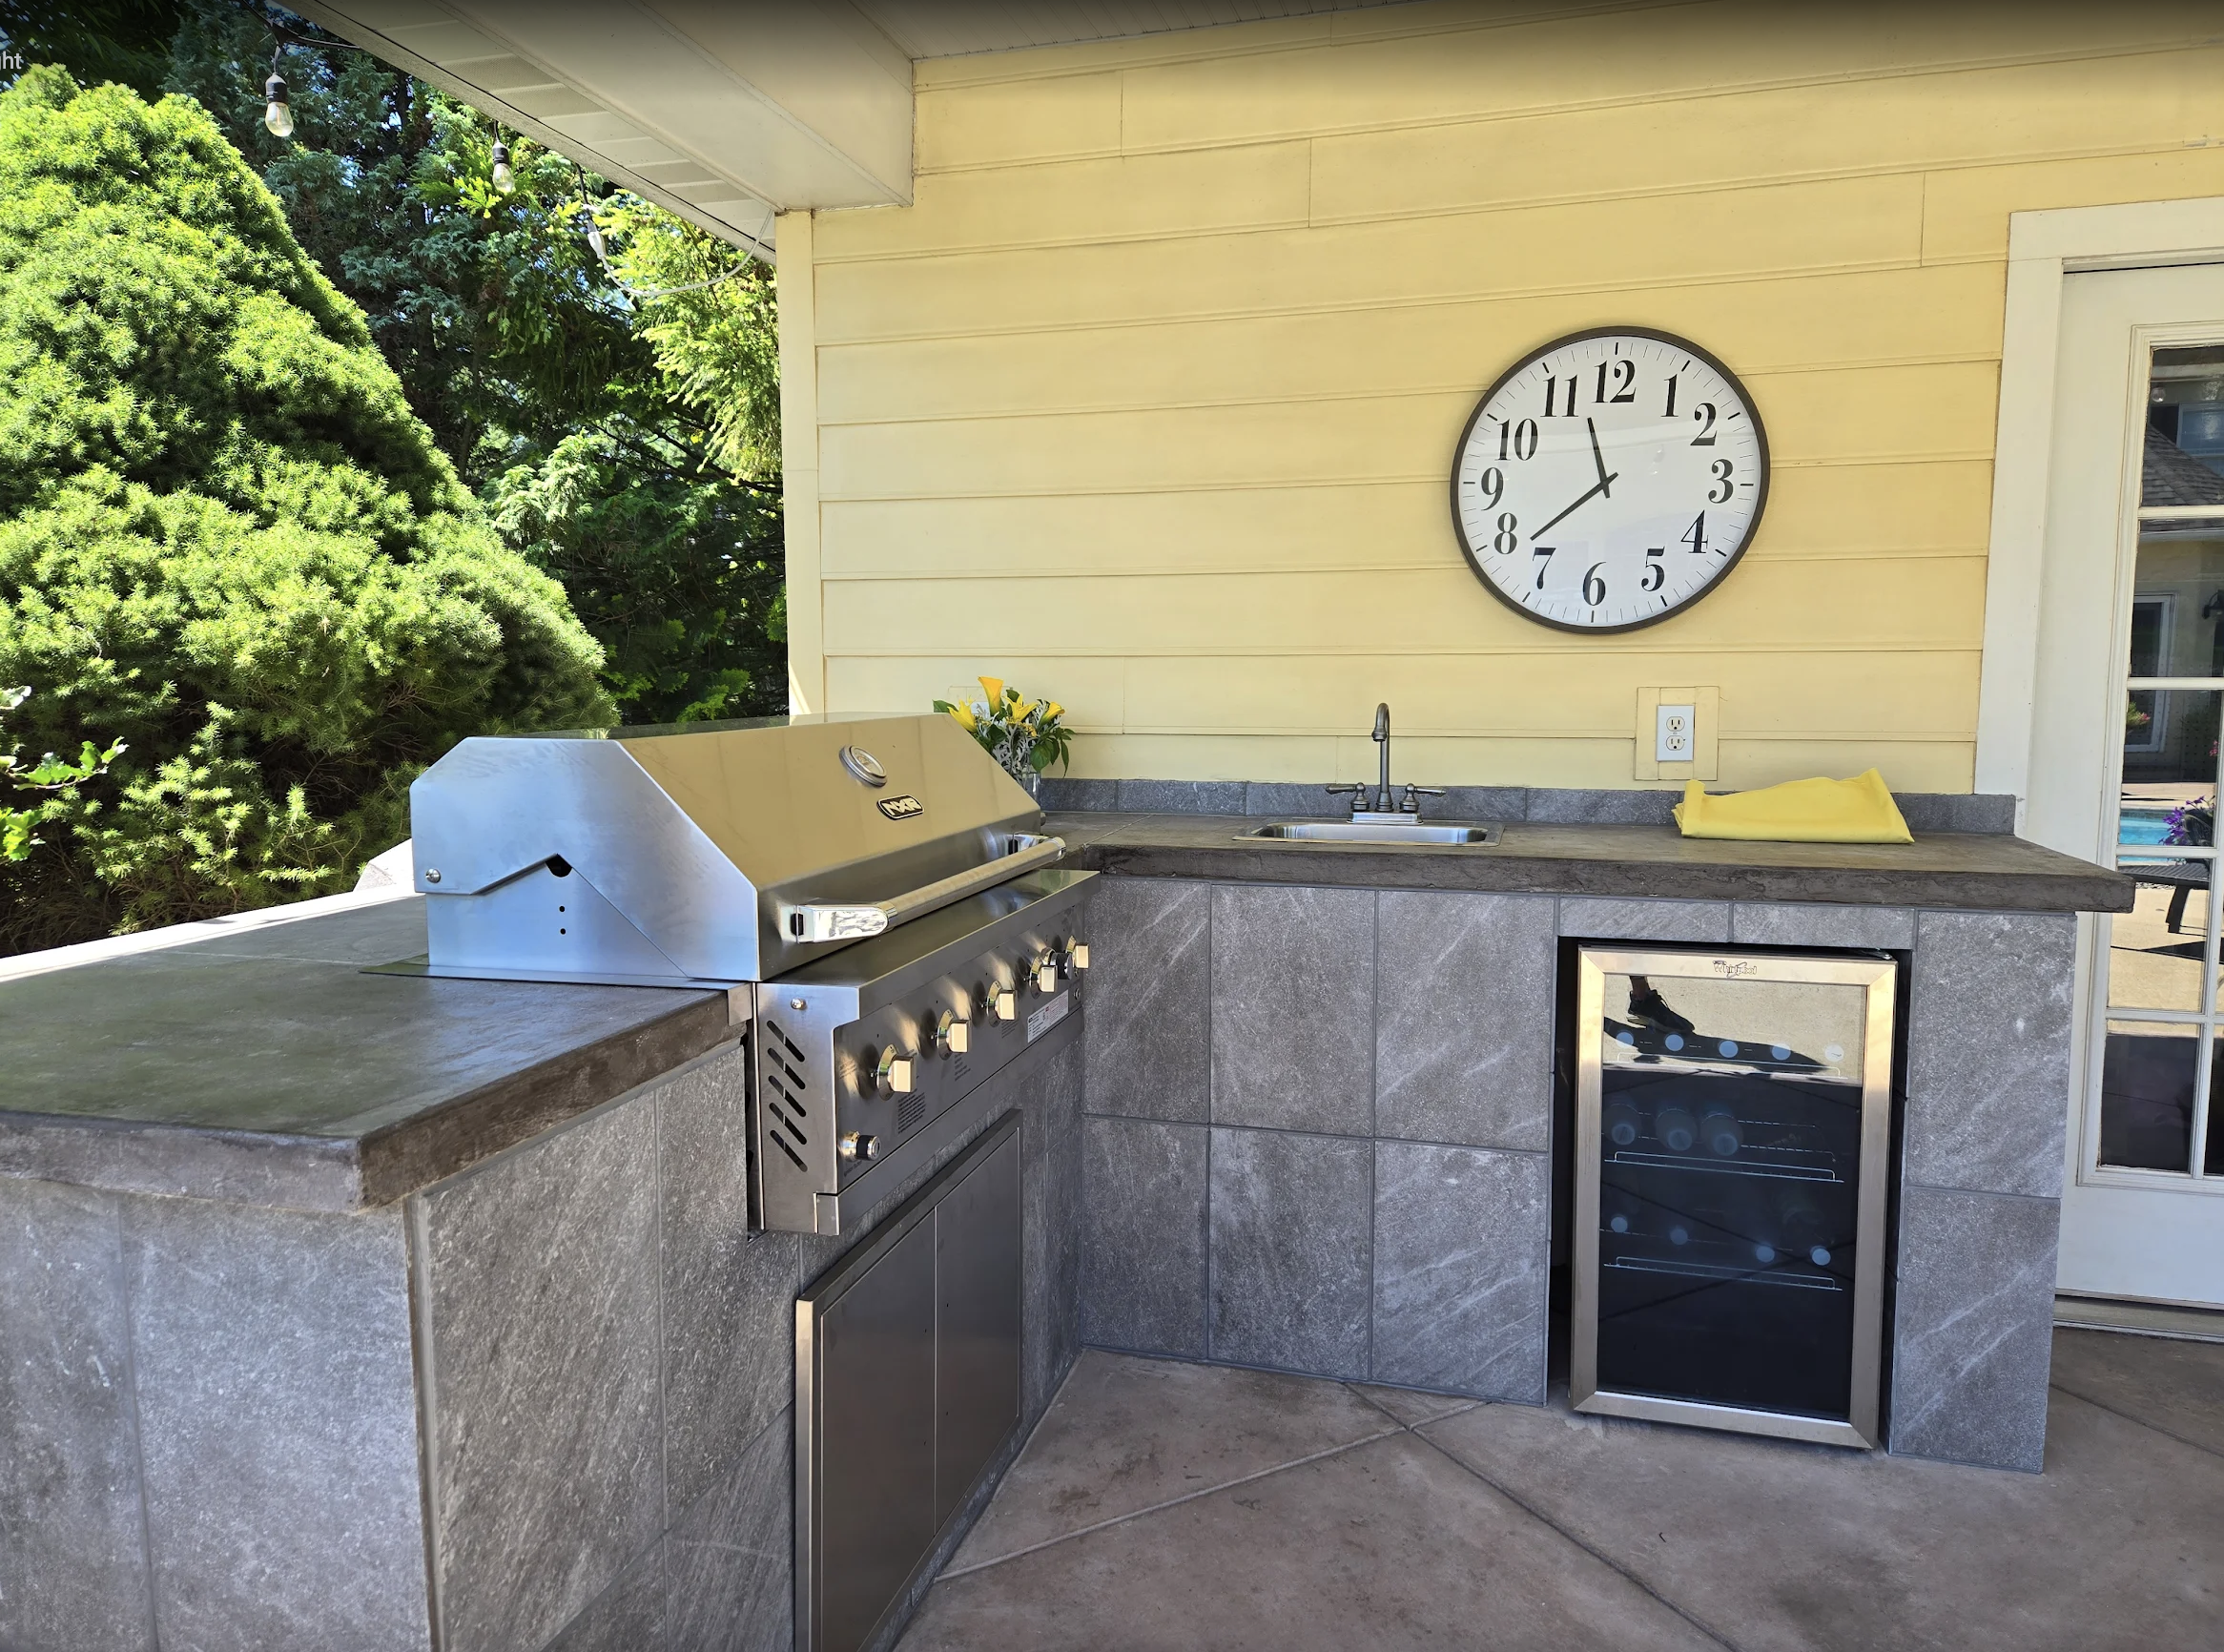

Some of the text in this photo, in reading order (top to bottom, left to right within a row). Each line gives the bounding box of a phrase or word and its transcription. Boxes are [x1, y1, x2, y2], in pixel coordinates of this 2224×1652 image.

[1539, 374, 1579, 418] 11
[1591, 360, 1637, 403] 12
[1660, 373, 1678, 418] 1
[1494, 418, 1538, 462] 10
[1689, 403, 1718, 446] 2
[1480, 466, 1504, 511] 9
[1707, 458, 1734, 504] 3
[1493, 512, 1518, 555] 8
[1680, 509, 1709, 554] 4
[1532, 547, 1556, 590] 7
[1582, 561, 1607, 607] 6
[1640, 546, 1666, 592] 5
[880, 797, 922, 816] NXR
